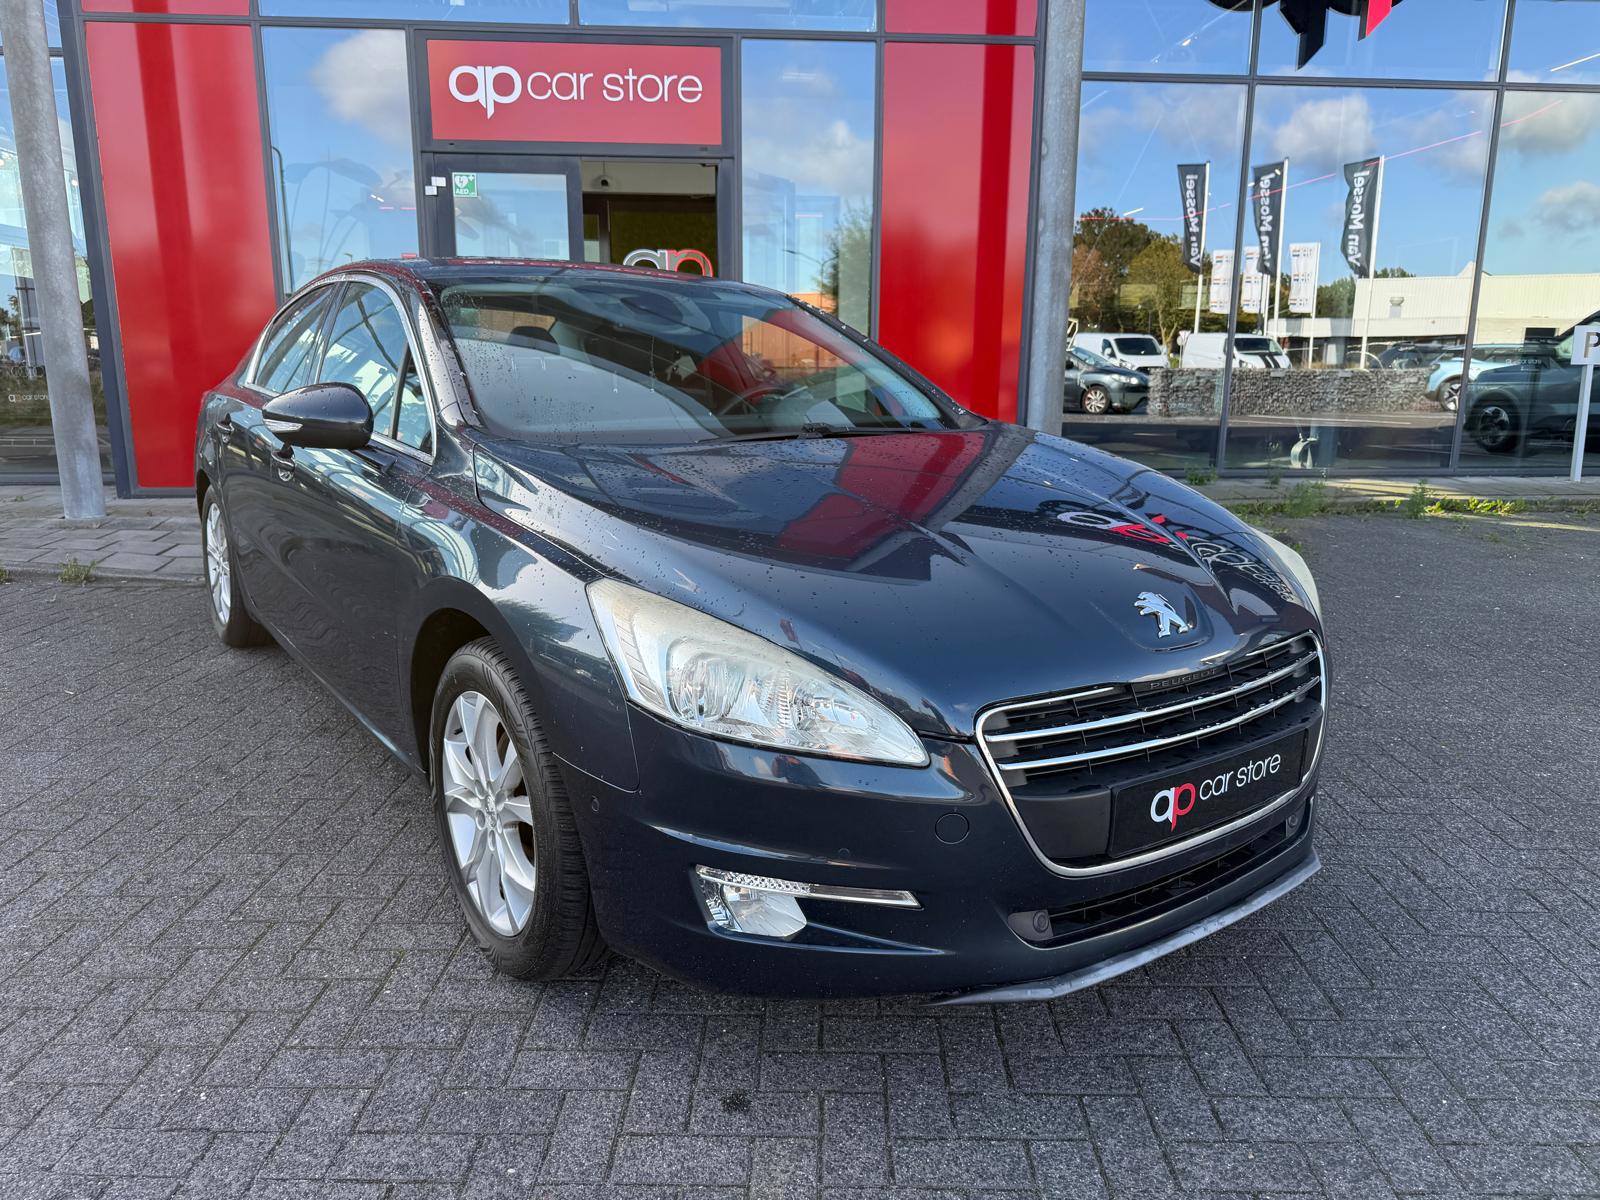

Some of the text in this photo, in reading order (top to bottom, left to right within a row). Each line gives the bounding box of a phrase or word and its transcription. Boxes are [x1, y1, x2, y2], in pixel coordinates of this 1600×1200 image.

[448, 65, 703, 120] ap car store
[1150, 668, 1217, 689] PEUGEOT
[1150, 753, 1281, 832] ap car store
